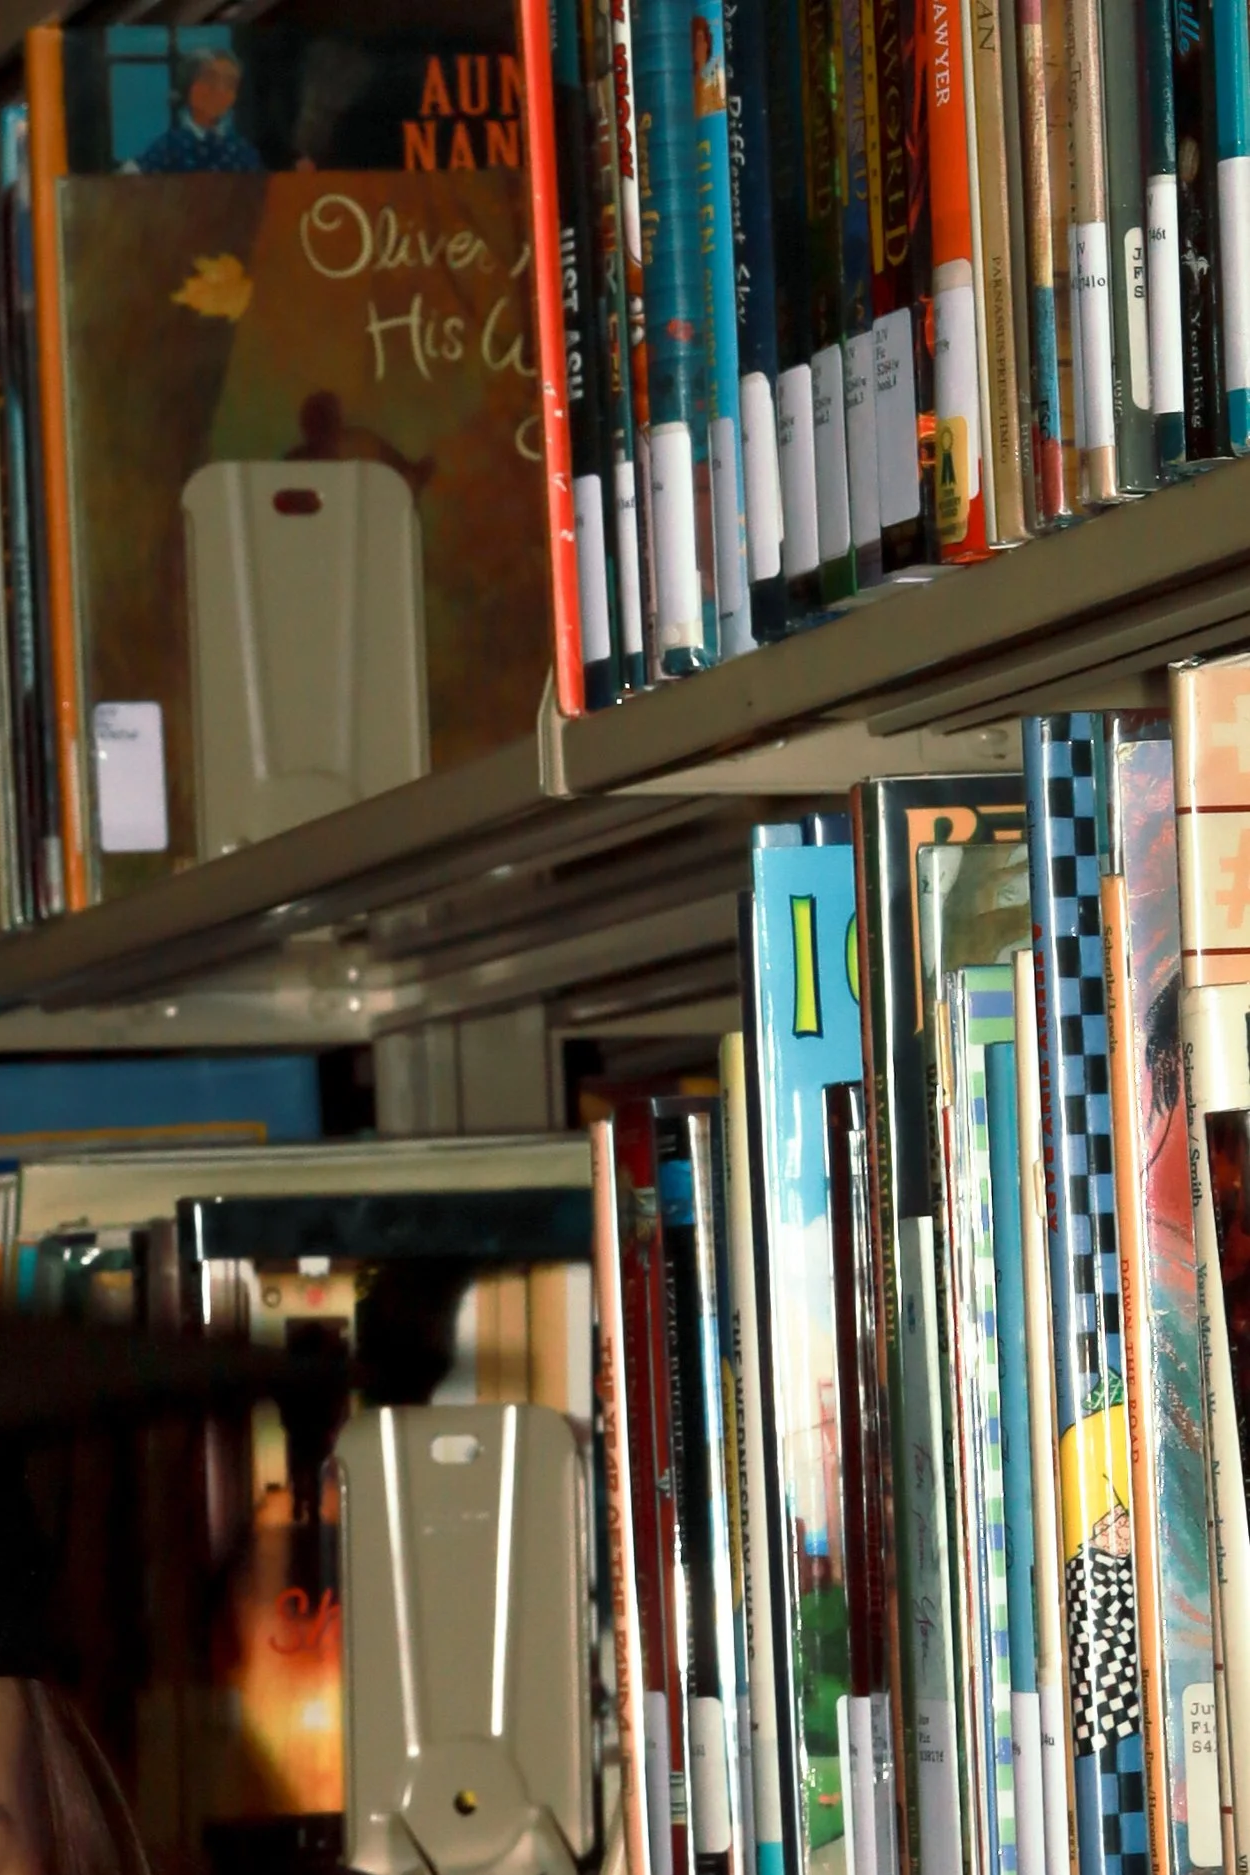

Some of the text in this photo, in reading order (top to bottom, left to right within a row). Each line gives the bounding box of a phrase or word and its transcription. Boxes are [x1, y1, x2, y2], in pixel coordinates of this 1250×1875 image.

[419, 54, 525, 116] AUN
[933, 0, 951, 108] AWYER
[402, 120, 520, 171] NAN
[729, 94, 746, 245] Different
[300, 193, 497, 278] Oliver
[737, 263, 751, 325] Sky
[366, 292, 464, 381] His
[1190, 311, 1204, 429] Yearling
[1190, 1148, 1203, 1208] Smith
[1120, 1258, 1140, 1465] DOWN THE ROAD
[1191, 1721, 1216, 1735] Fi
[1192, 1739, 1216, 1754] S4
